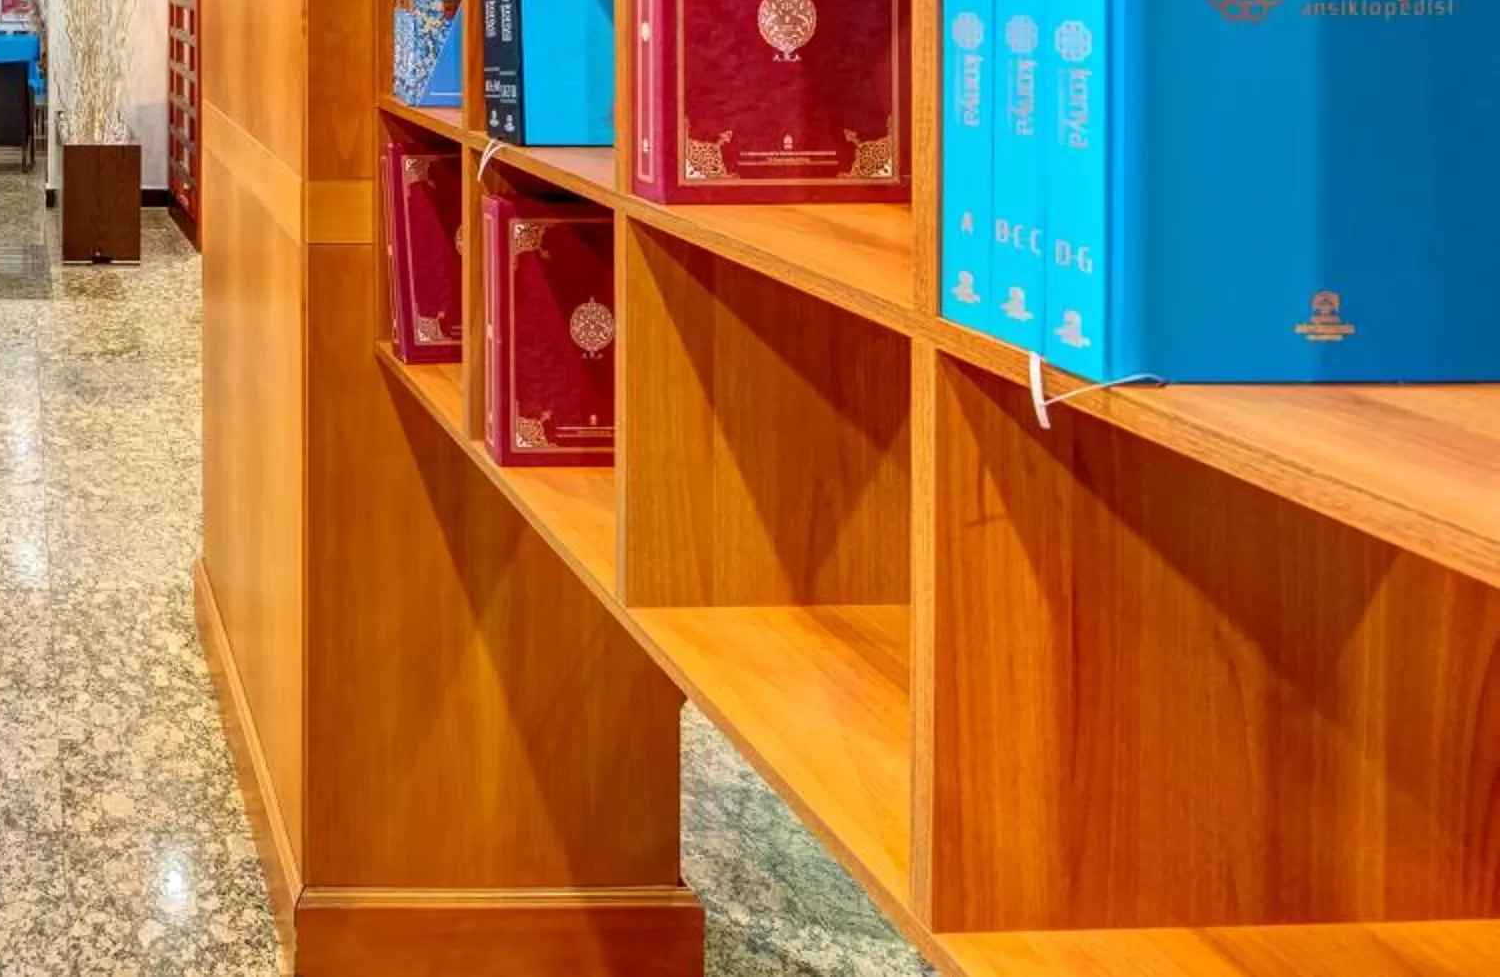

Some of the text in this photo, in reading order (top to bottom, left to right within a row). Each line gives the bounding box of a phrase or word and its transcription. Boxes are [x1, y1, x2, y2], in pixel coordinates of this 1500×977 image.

[962, 54, 984, 128] konya
[1014, 59, 1038, 136] konya
[1066, 69, 1093, 149] konya
[960, 211, 974, 236] A
[1055, 238, 1093, 274] D-G
